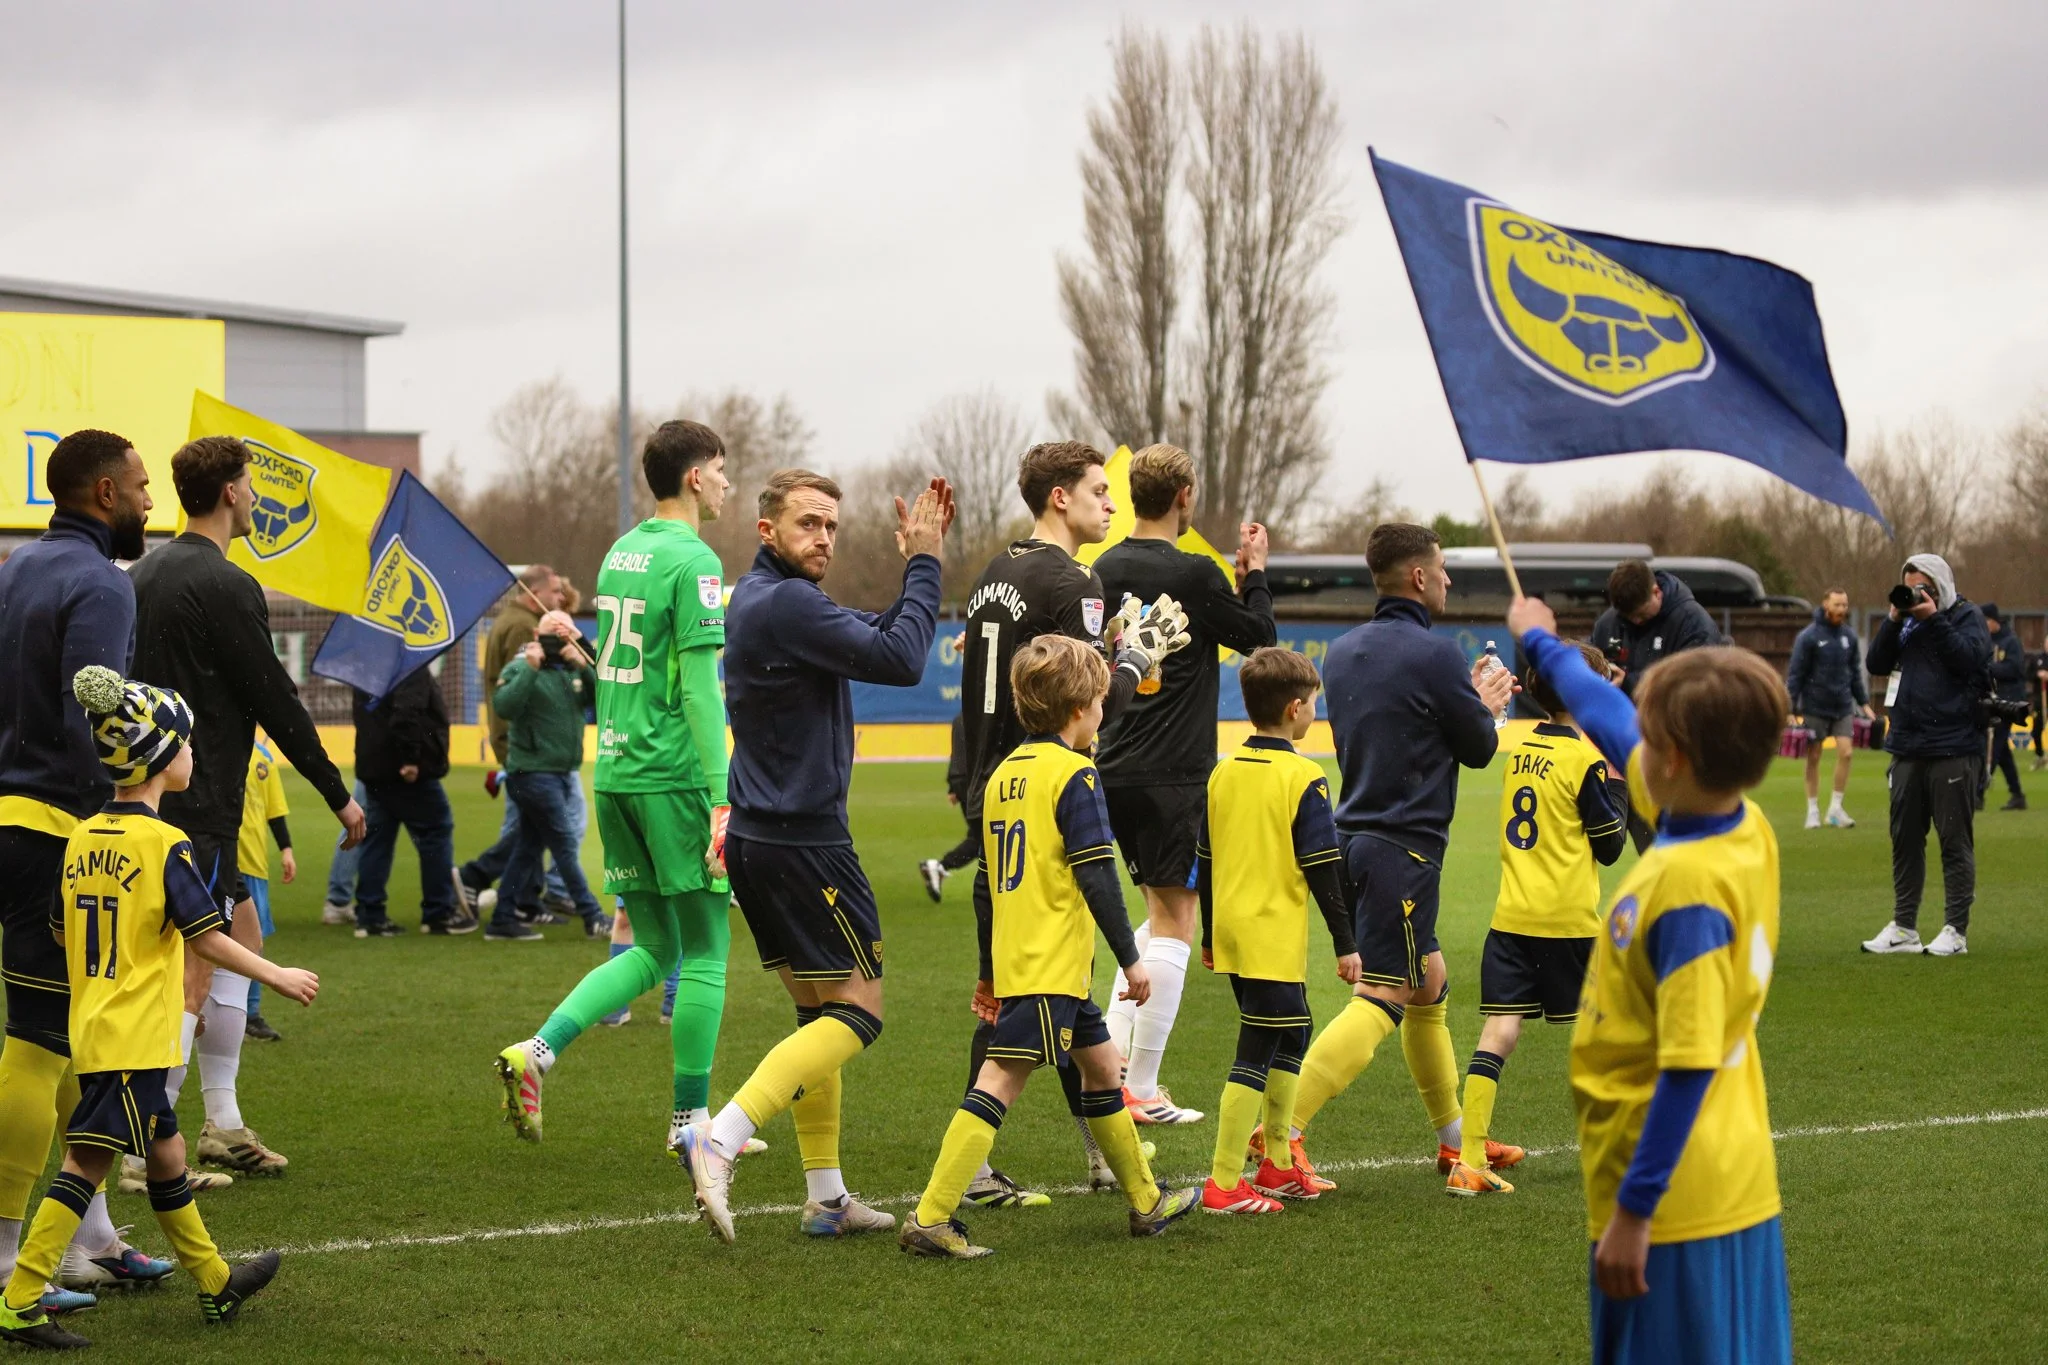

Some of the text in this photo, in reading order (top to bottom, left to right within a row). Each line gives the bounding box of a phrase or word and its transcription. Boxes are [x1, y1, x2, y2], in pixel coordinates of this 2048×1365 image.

[252, 452, 304, 484] OXFORD
[260, 471, 297, 491] UNITED
[608, 551, 654, 573] BEADLE
[967, 581, 1027, 622] CUMMING
[596, 594, 646, 684] 25
[981, 621, 1000, 714] 1
[1512, 754, 1554, 780] JAKE
[1000, 777, 1026, 803] LEO
[1505, 785, 1538, 850] 8
[66, 849, 142, 893] SAMUEL
[989, 818, 1026, 893] 10
[76, 893, 119, 980] 11
